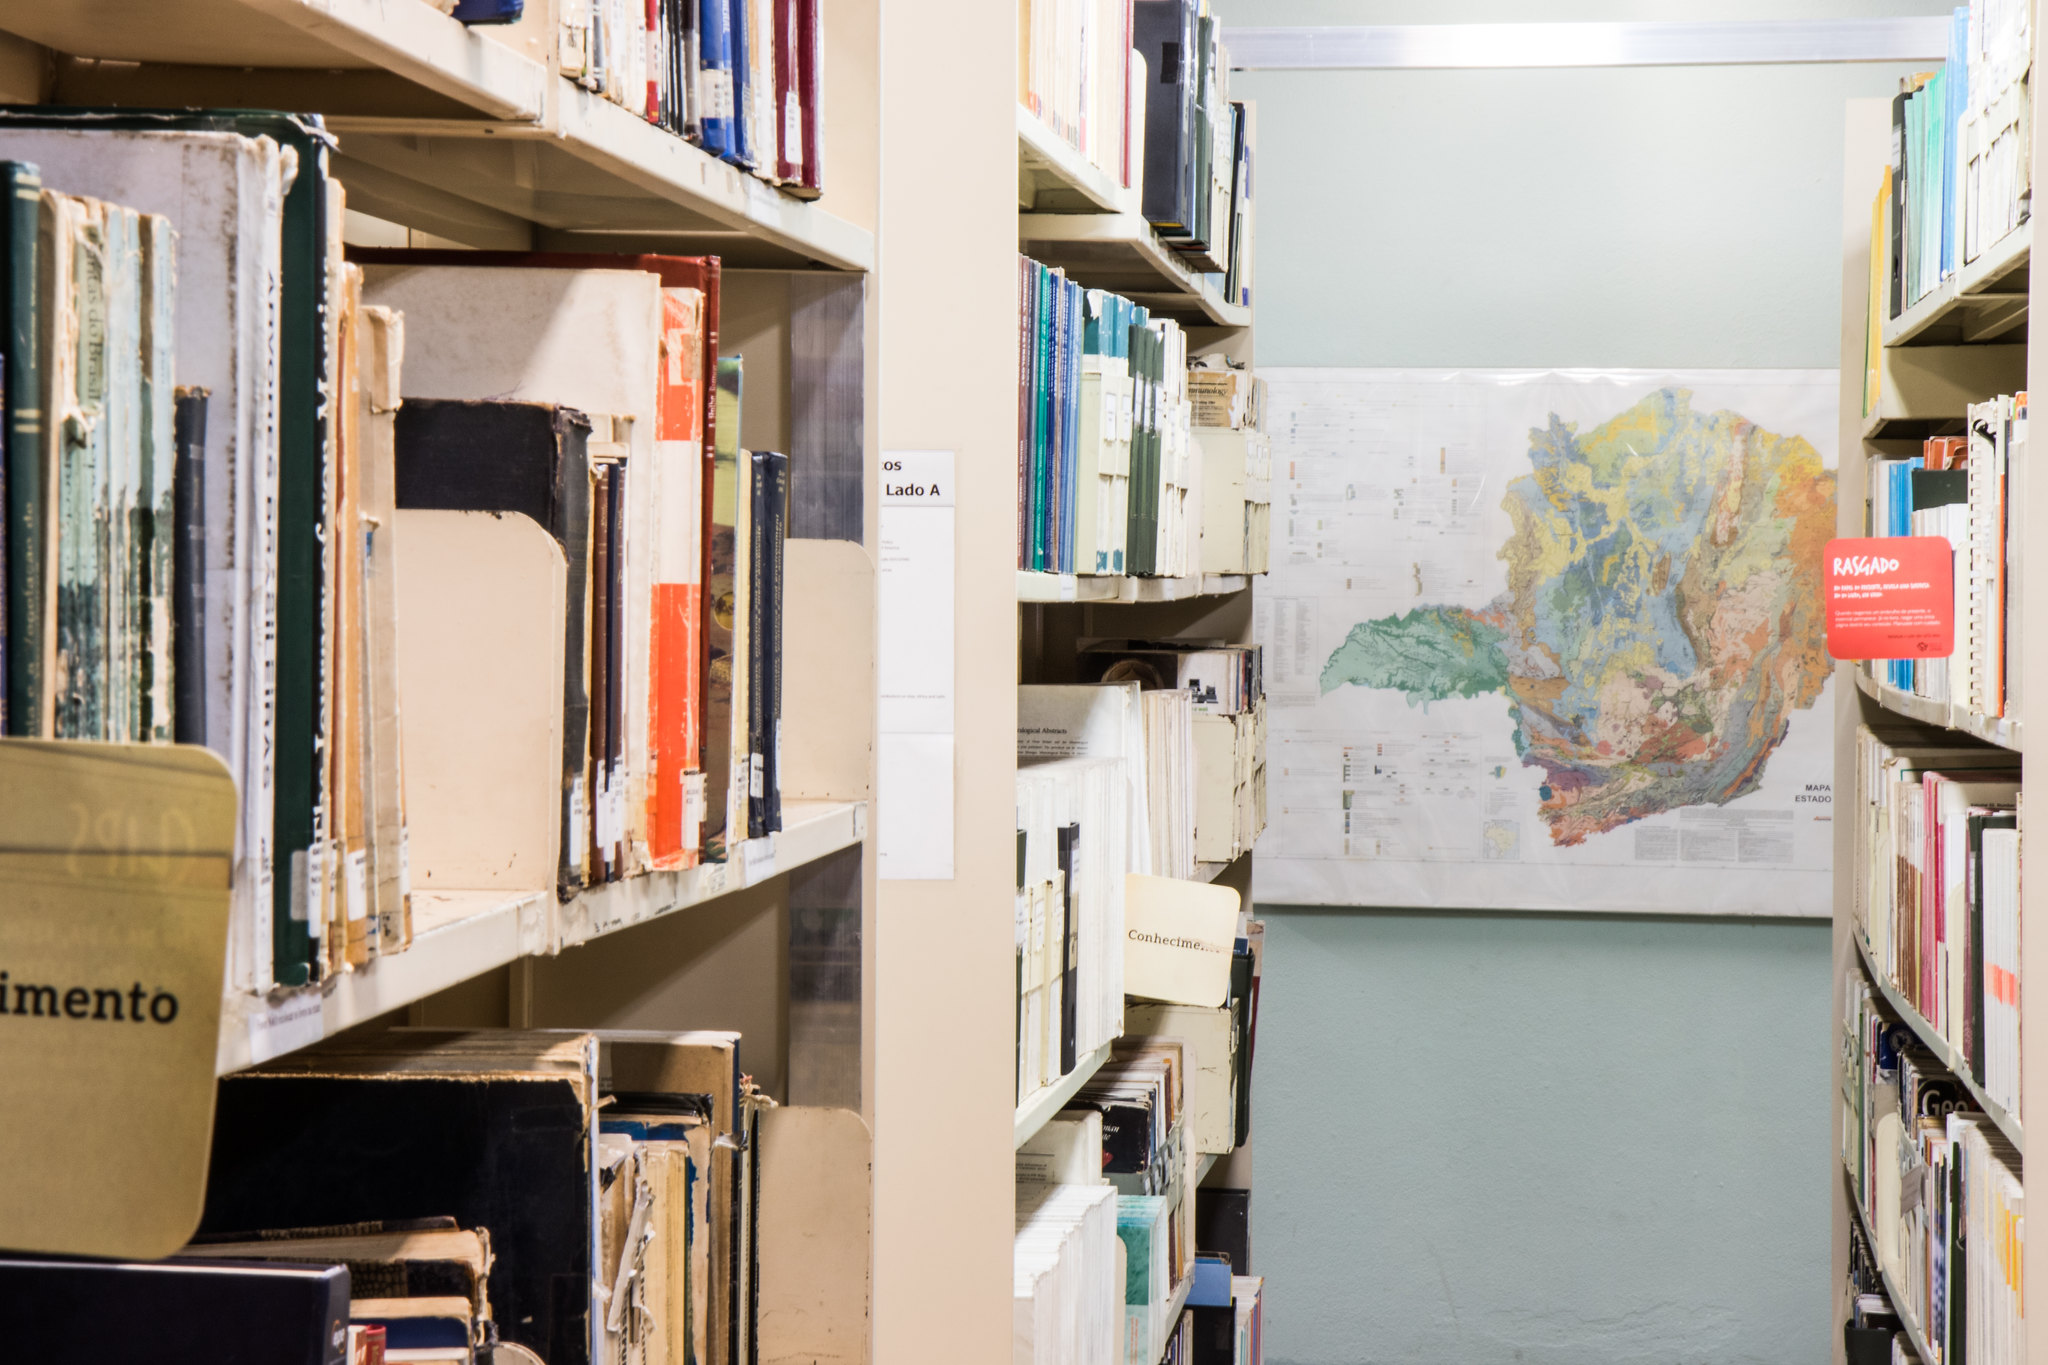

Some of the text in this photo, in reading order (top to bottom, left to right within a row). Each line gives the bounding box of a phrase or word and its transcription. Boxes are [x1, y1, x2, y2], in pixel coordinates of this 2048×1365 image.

[87, 341, 103, 400] Brasil
[882, 461, 902, 471] os
[886, 483, 941, 496] Lado A
[1834, 556, 1899, 576] RASGADO
